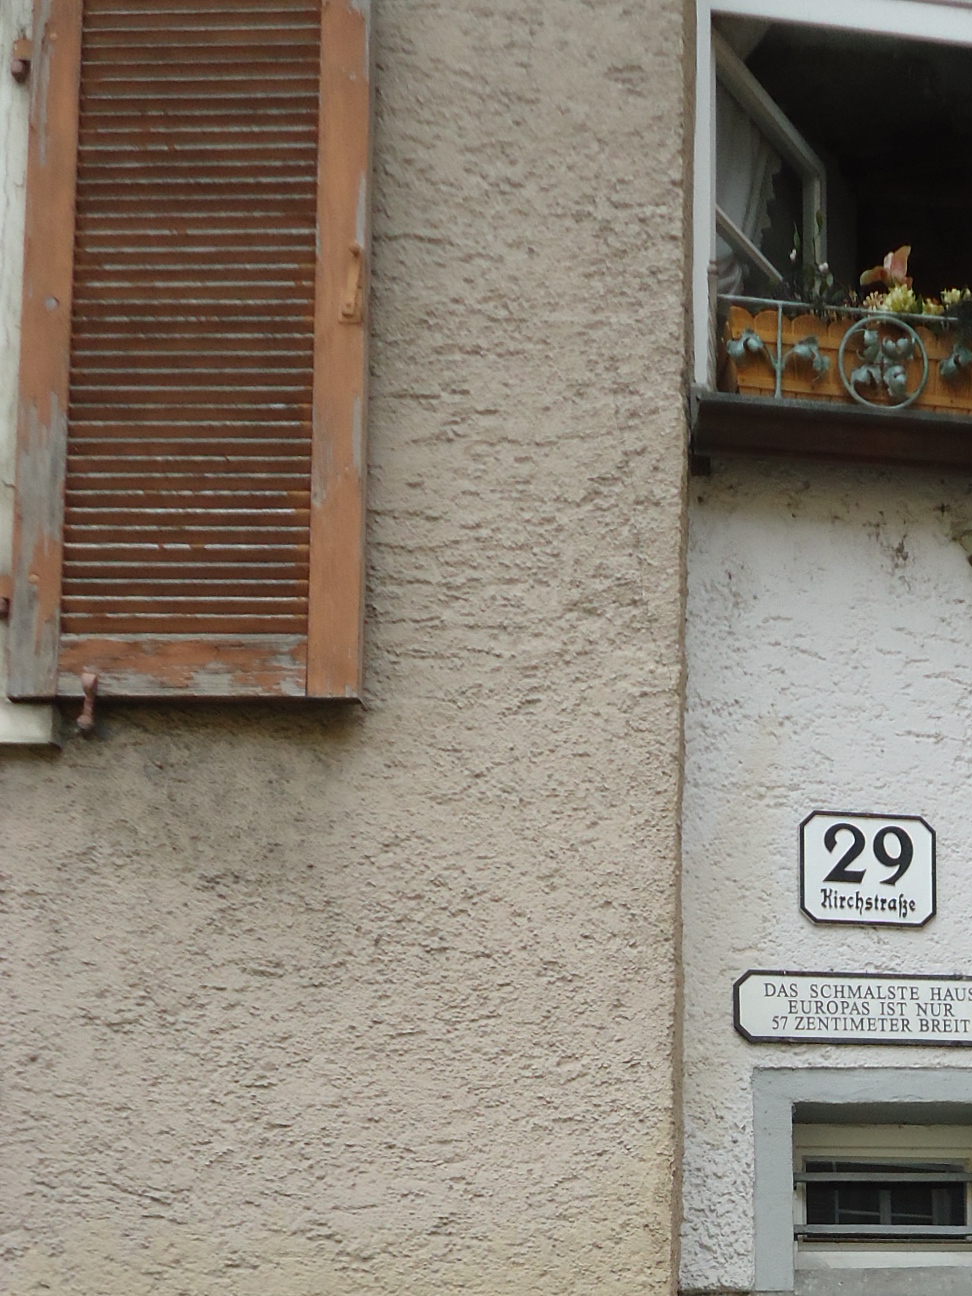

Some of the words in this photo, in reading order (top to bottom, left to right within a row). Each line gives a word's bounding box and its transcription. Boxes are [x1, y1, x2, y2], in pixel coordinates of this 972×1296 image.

[823, 823, 914, 886] 29
[820, 888, 916, 918] Kirchstraße
[764, 983, 798, 998] DAS
[810, 984, 920, 1000] SCHMALSTE
[788, 1000, 870, 1015] EUROPAS
[880, 1001, 907, 1016] IST
[916, 1002, 955, 1017] NUR
[772, 1016, 787, 1030] 57
[794, 1017, 912, 1032] ZENTIMETER
[919, 1018, 970, 1033] BREIT
